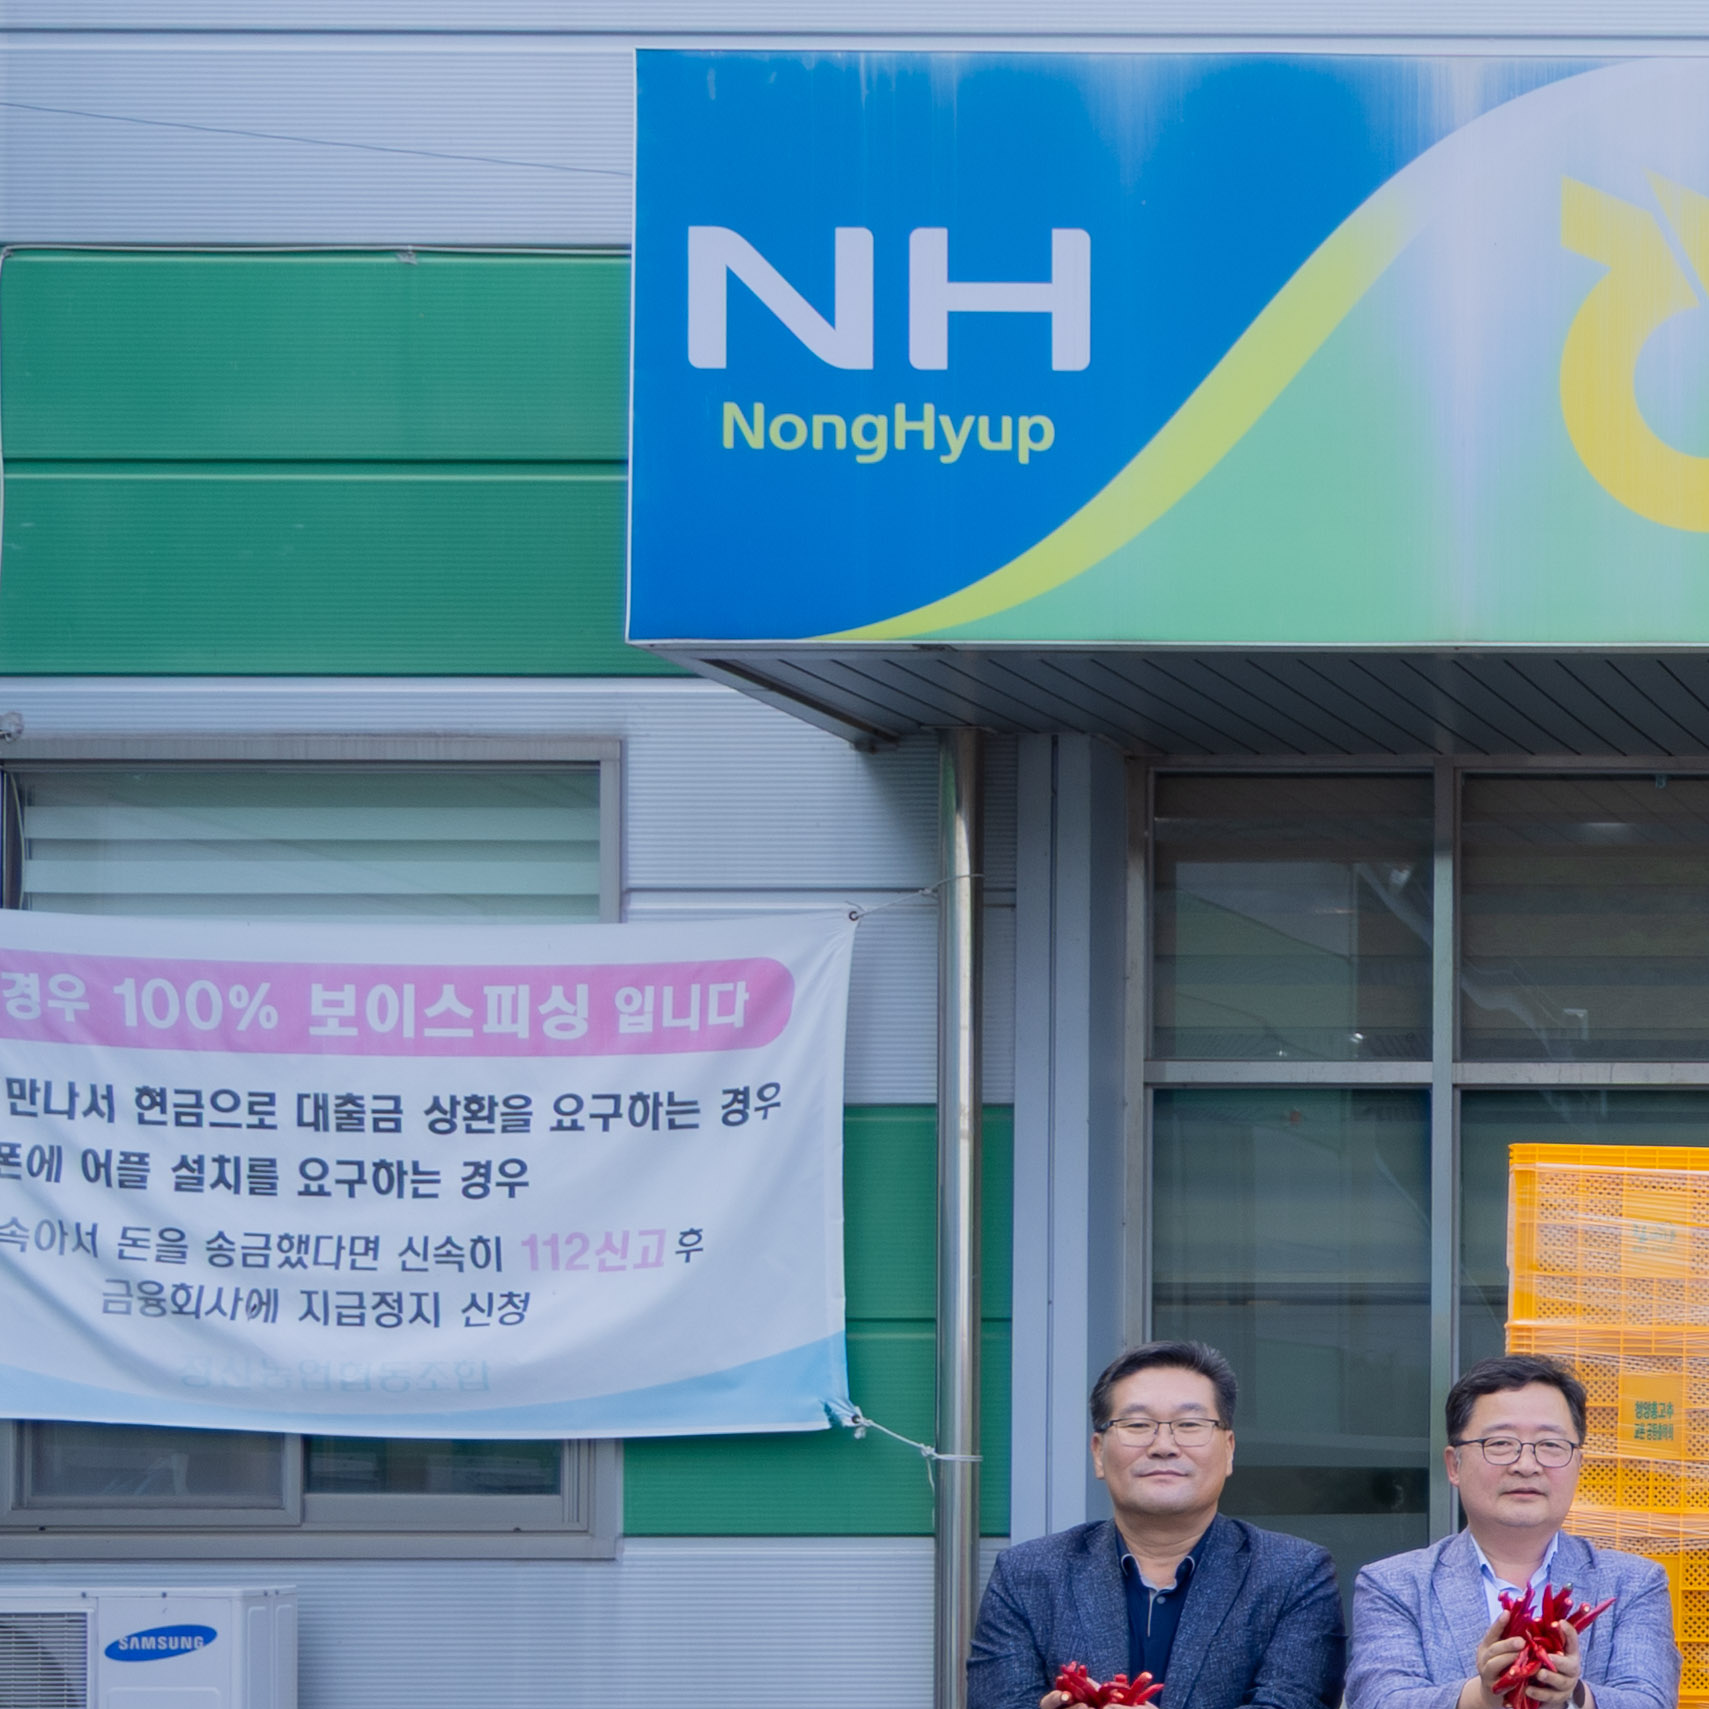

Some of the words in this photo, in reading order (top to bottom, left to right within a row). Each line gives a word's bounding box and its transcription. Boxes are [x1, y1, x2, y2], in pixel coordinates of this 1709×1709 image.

[688, 226, 1091, 370] NH
[721, 402, 1055, 464] NongHyup
[0, 972, 90, 1022] 경우
[113, 977, 278, 1031] 100%
[309, 983, 589, 1040] 보이스피싱
[614, 981, 750, 1034] 입니다
[5, 1076, 115, 1123] 만나서
[134, 1085, 278, 1130] 현금으로
[296, 1093, 403, 1133] 대출금
[423, 1093, 533, 1135] 상환을
[549, 1091, 701, 1132] 요구하는
[720, 1082, 782, 1127] 경우
[80, 1149, 151, 1190] 어플
[171, 1154, 279, 1196] 설치를
[297, 1157, 442, 1199] 요구하는
[460, 1158, 529, 1200] 경우
[0, 1216, 99, 1258] 속아서
[117, 1226, 189, 1265] 돈을
[205, 1230, 381, 1271] 송금했다면
[398, 1235, 503, 1273] 신속히
[521, 1228, 668, 1273] 112신고
[675, 1227, 705, 1263] 후
[102, 1278, 279, 1323] 금융회사에
[298, 1289, 441, 1329] 지급정지
[461, 1291, 531, 1328] 신청
[118, 1636, 204, 1651] SAMSUNG
